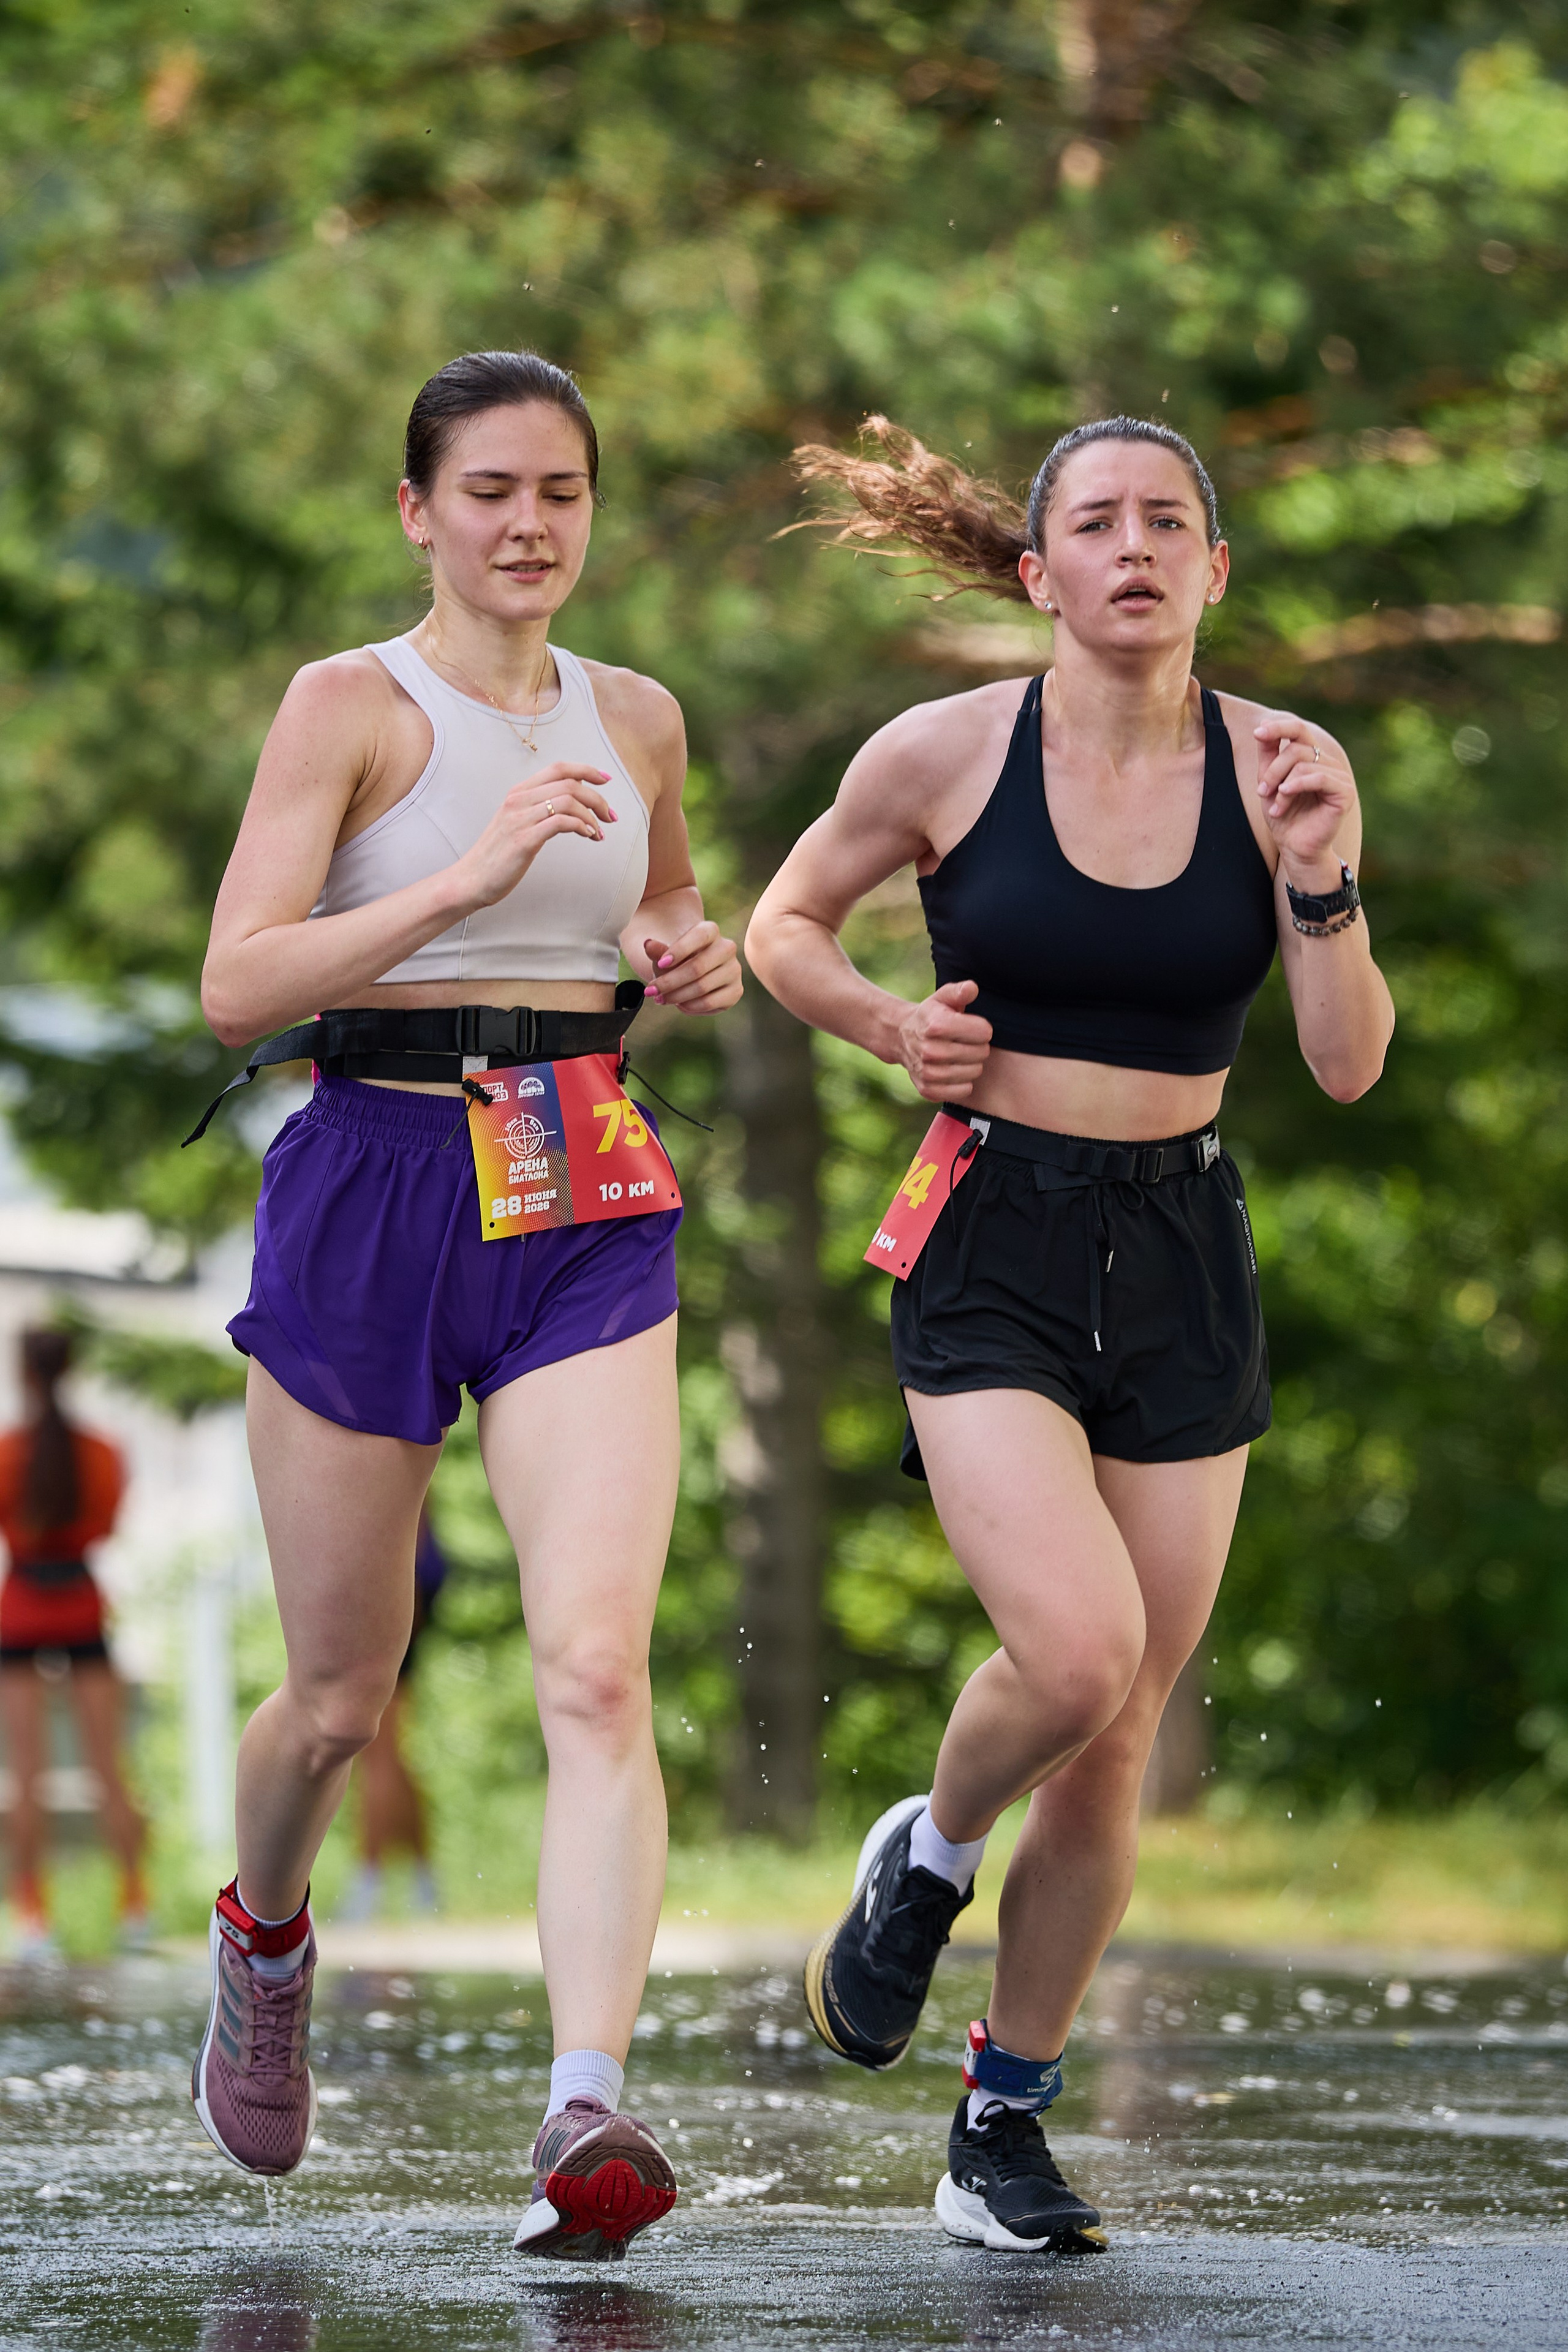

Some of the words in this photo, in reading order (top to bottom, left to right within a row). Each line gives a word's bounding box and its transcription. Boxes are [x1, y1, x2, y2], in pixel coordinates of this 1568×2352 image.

[593, 1099, 648, 1153] 75
[508, 1156, 549, 1175] АРЕНА
[508, 1169, 549, 1185] БИАТЛОНА
[599, 1183, 622, 1201] 10
[628, 1180, 654, 1198] КМ
[492, 1195, 522, 1219] 28
[524, 1189, 557, 1204] ИЮНЯ
[524, 1201, 549, 1214] 2026
[224, 1923, 239, 1938] 75
